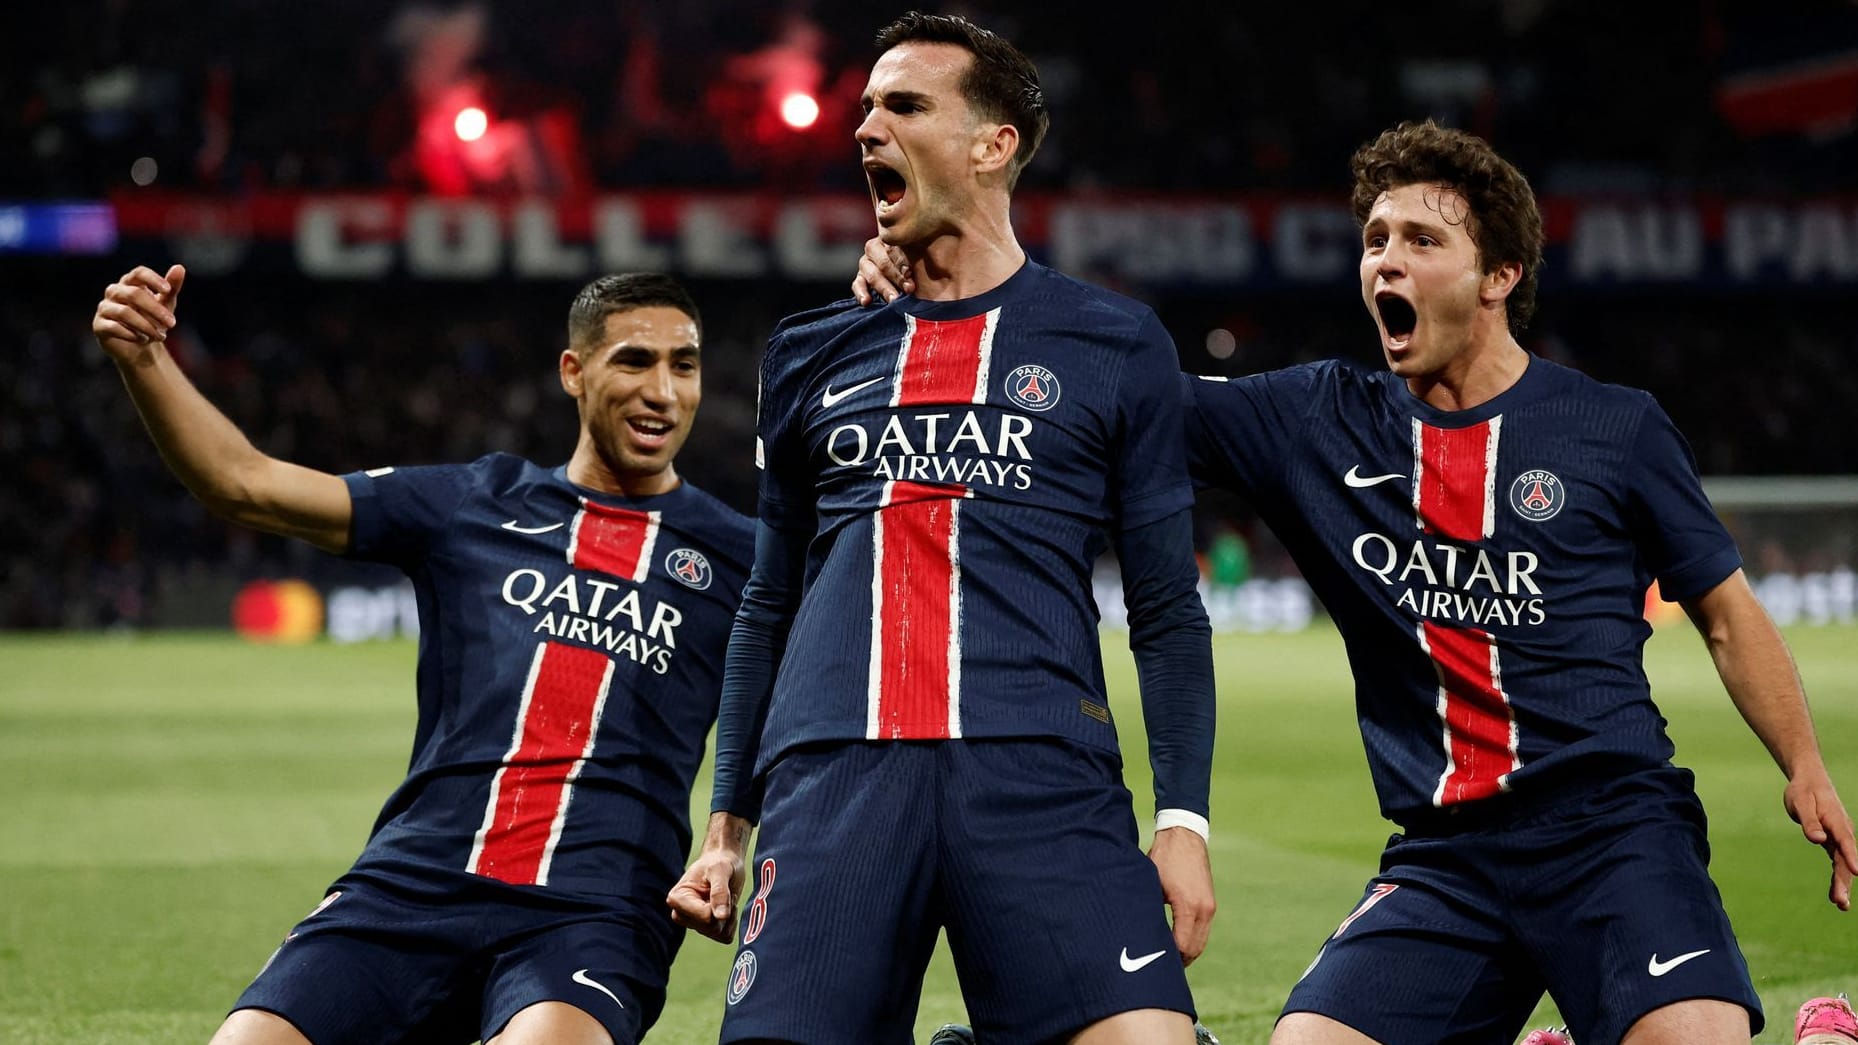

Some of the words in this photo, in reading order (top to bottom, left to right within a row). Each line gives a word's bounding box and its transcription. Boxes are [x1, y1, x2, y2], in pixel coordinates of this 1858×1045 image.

[296, 200, 874, 279] COLLEC
[1016, 367, 1052, 381] PARIS
[827, 410, 1033, 466] QATAR
[873, 455, 1032, 490] AIRWAYS
[1520, 473, 1556, 485] PARIS
[676, 551, 707, 569] PARIS
[1352, 533, 1543, 594] QATAR
[502, 568, 683, 649] QATAR
[1397, 588, 1546, 626] AIRWAYS
[533, 611, 673, 675] AIRWAYS
[743, 857, 777, 945] 8
